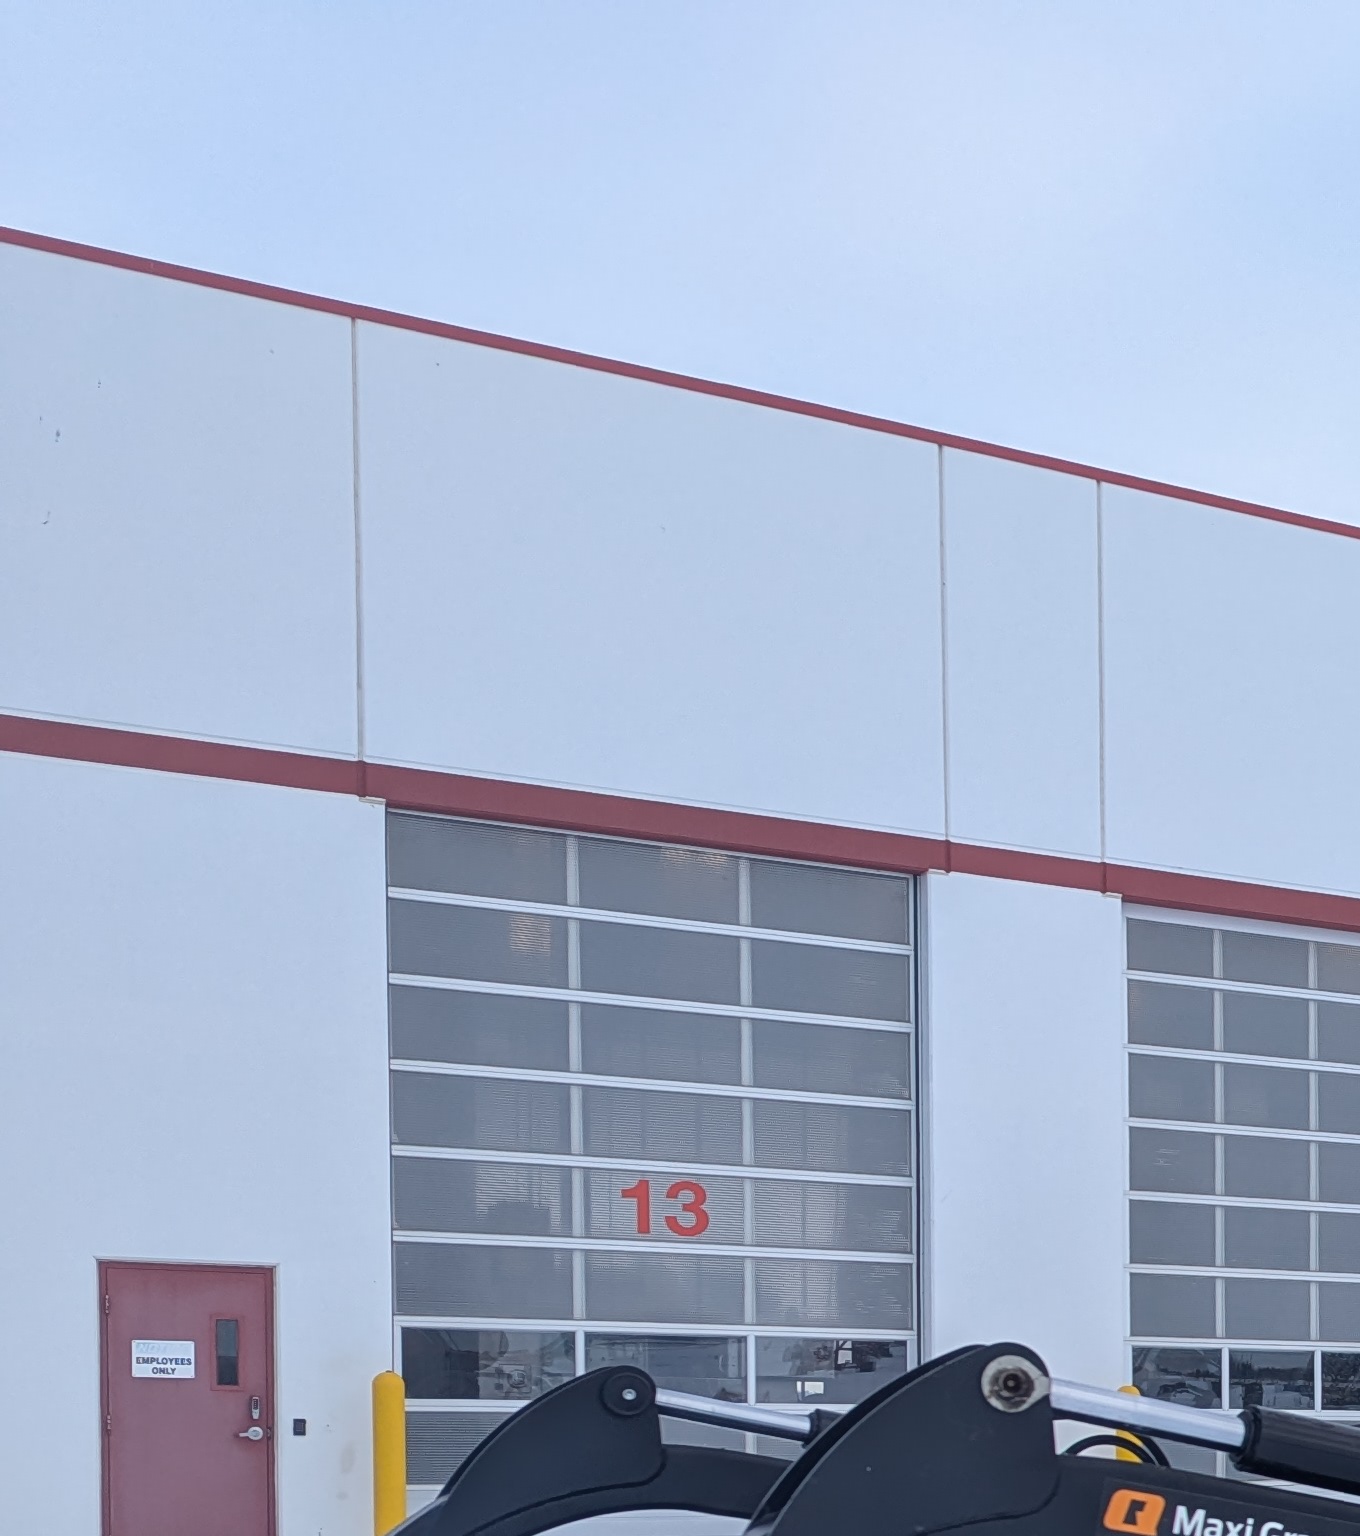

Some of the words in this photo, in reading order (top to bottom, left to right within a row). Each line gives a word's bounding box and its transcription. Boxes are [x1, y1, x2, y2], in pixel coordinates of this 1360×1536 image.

[620, 1179, 710, 1236] 13
[136, 1356, 192, 1366] EMPLOYEES
[151, 1366, 177, 1375] ONLY
